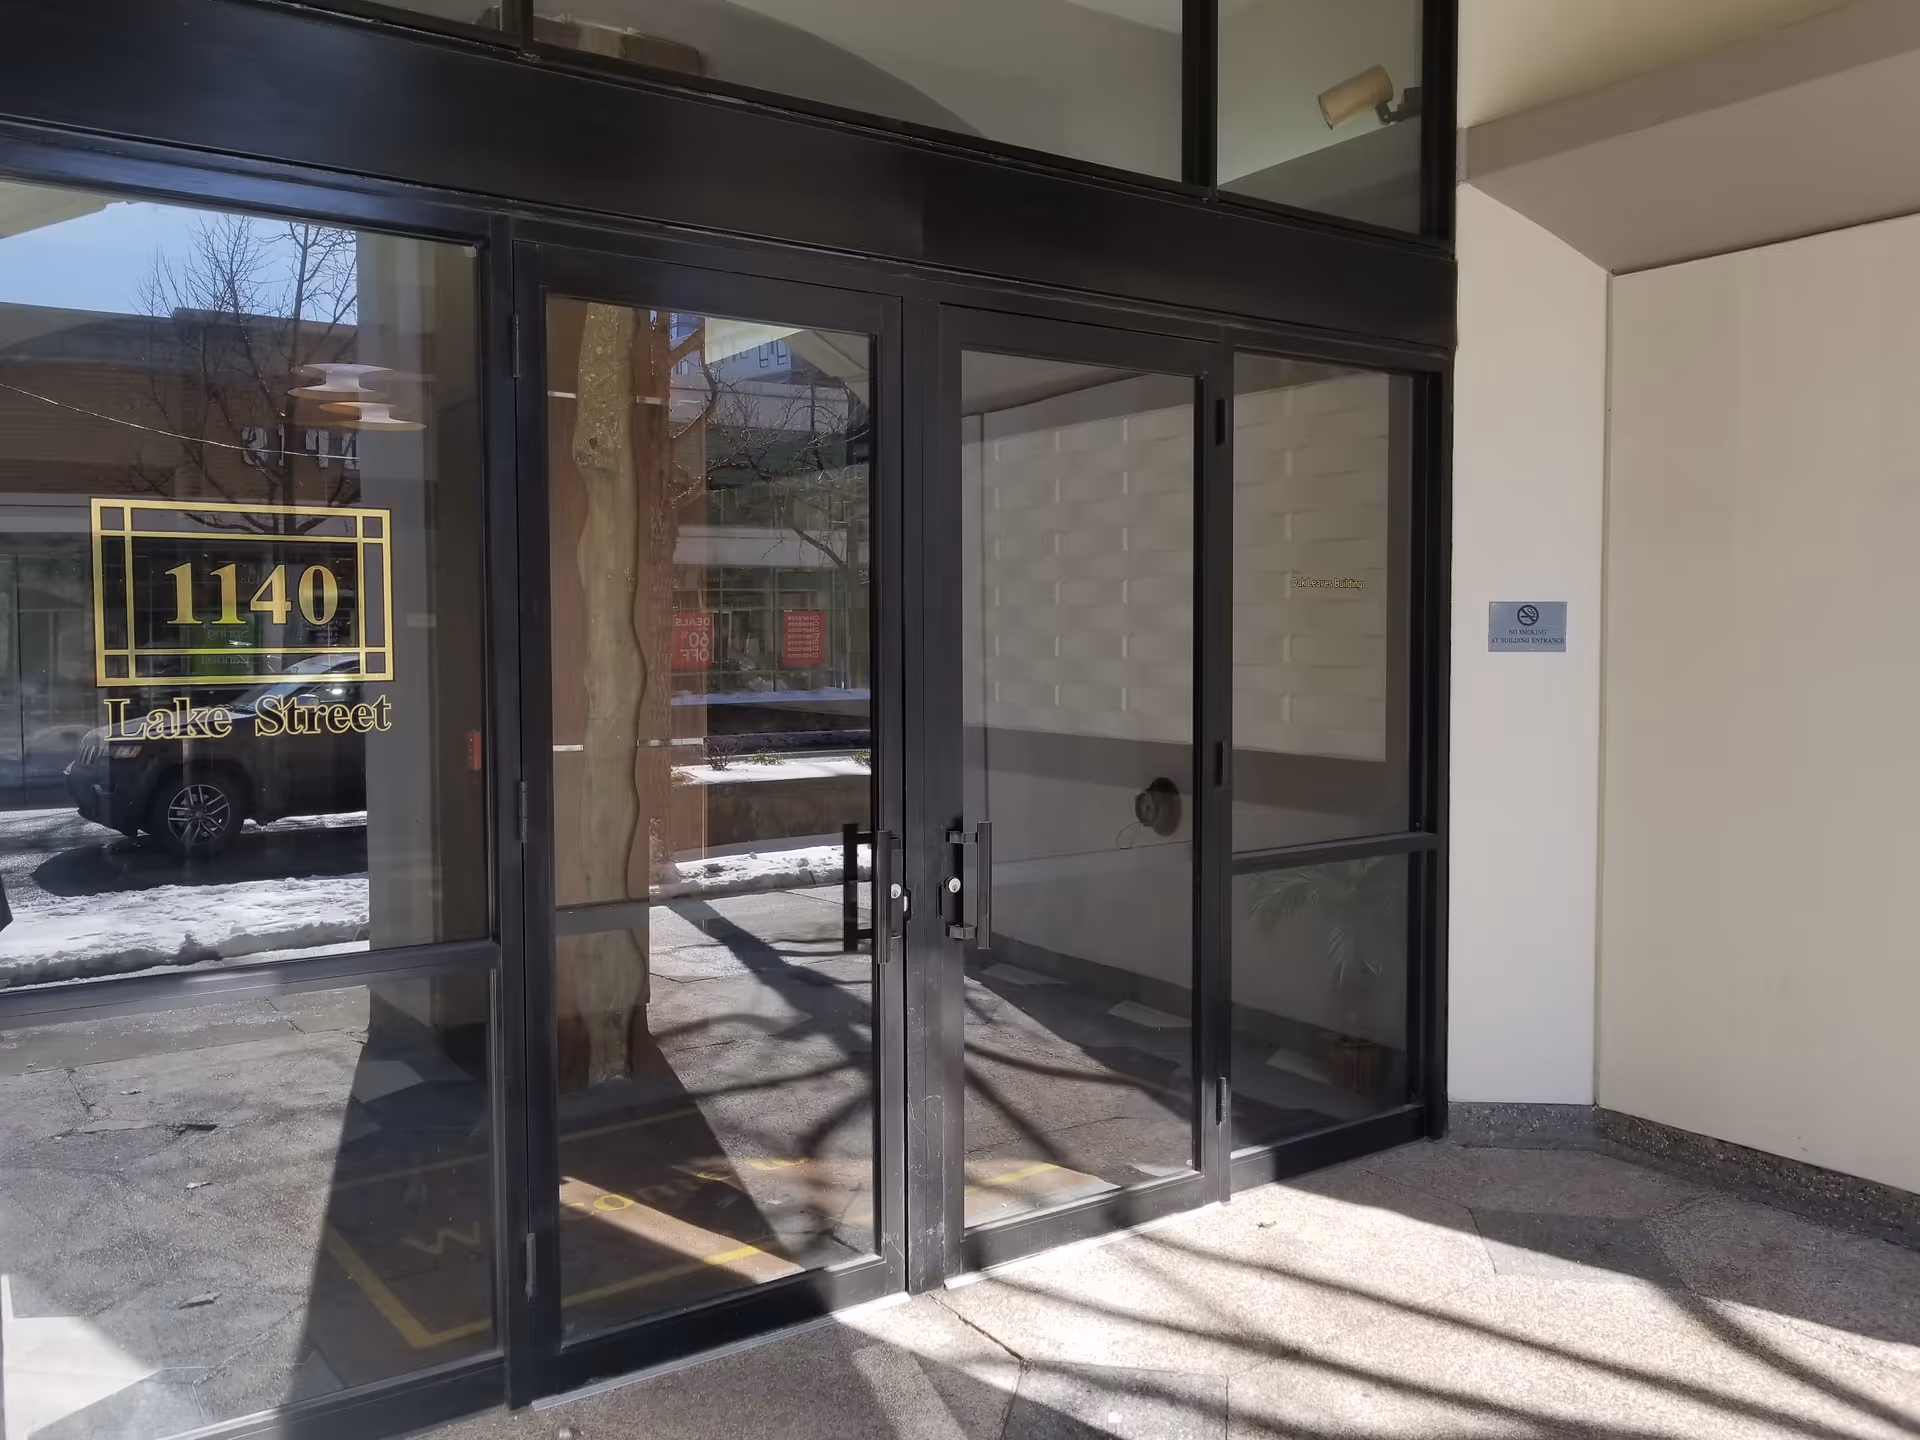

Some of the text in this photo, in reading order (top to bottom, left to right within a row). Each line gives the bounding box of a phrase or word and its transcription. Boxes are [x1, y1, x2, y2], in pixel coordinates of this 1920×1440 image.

[164, 562, 339, 625] 1140
[1290, 577, 1363, 591] Oak Leaves Building
[103, 693, 393, 742] Lake Street
